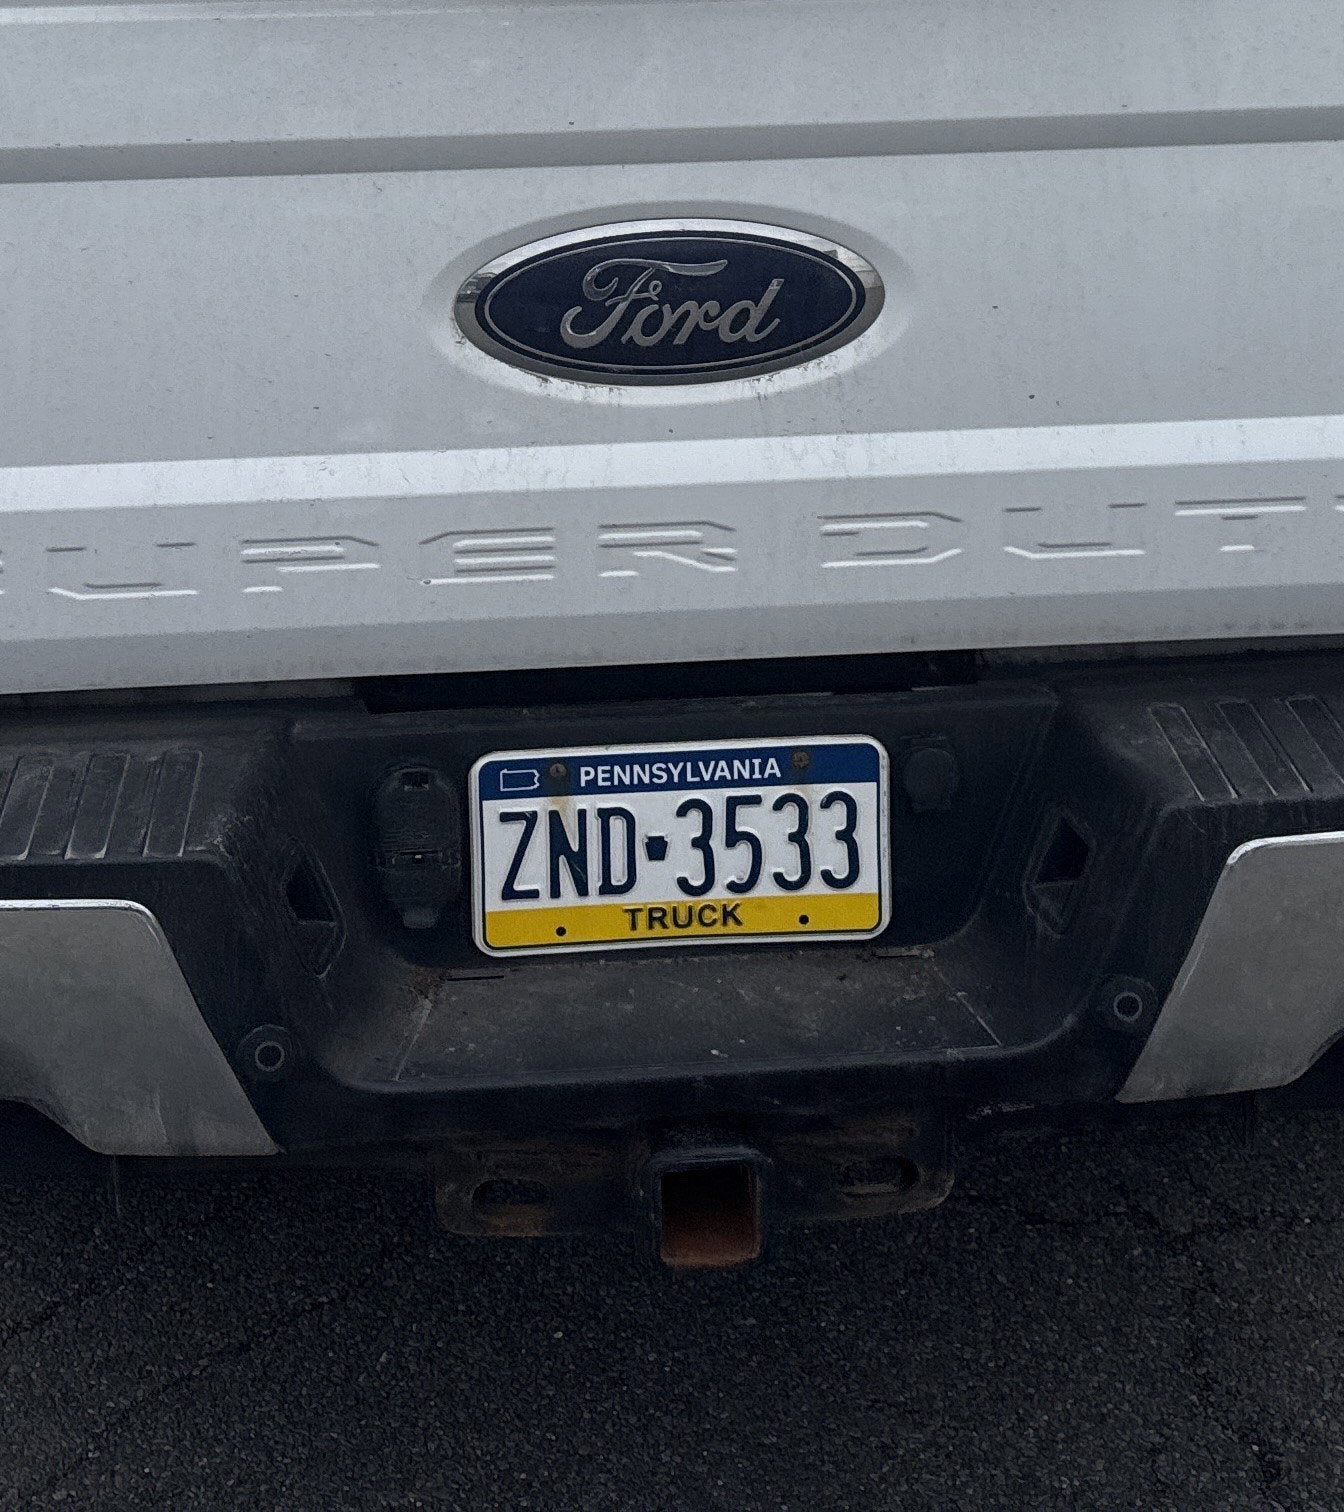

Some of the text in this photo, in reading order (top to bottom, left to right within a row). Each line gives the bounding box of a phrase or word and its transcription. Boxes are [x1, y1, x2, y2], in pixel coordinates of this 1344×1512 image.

[560, 257, 781, 348] Ford
[579, 757, 782, 787] PENNSYLVANIA
[623, 902, 744, 932] TRUCK
